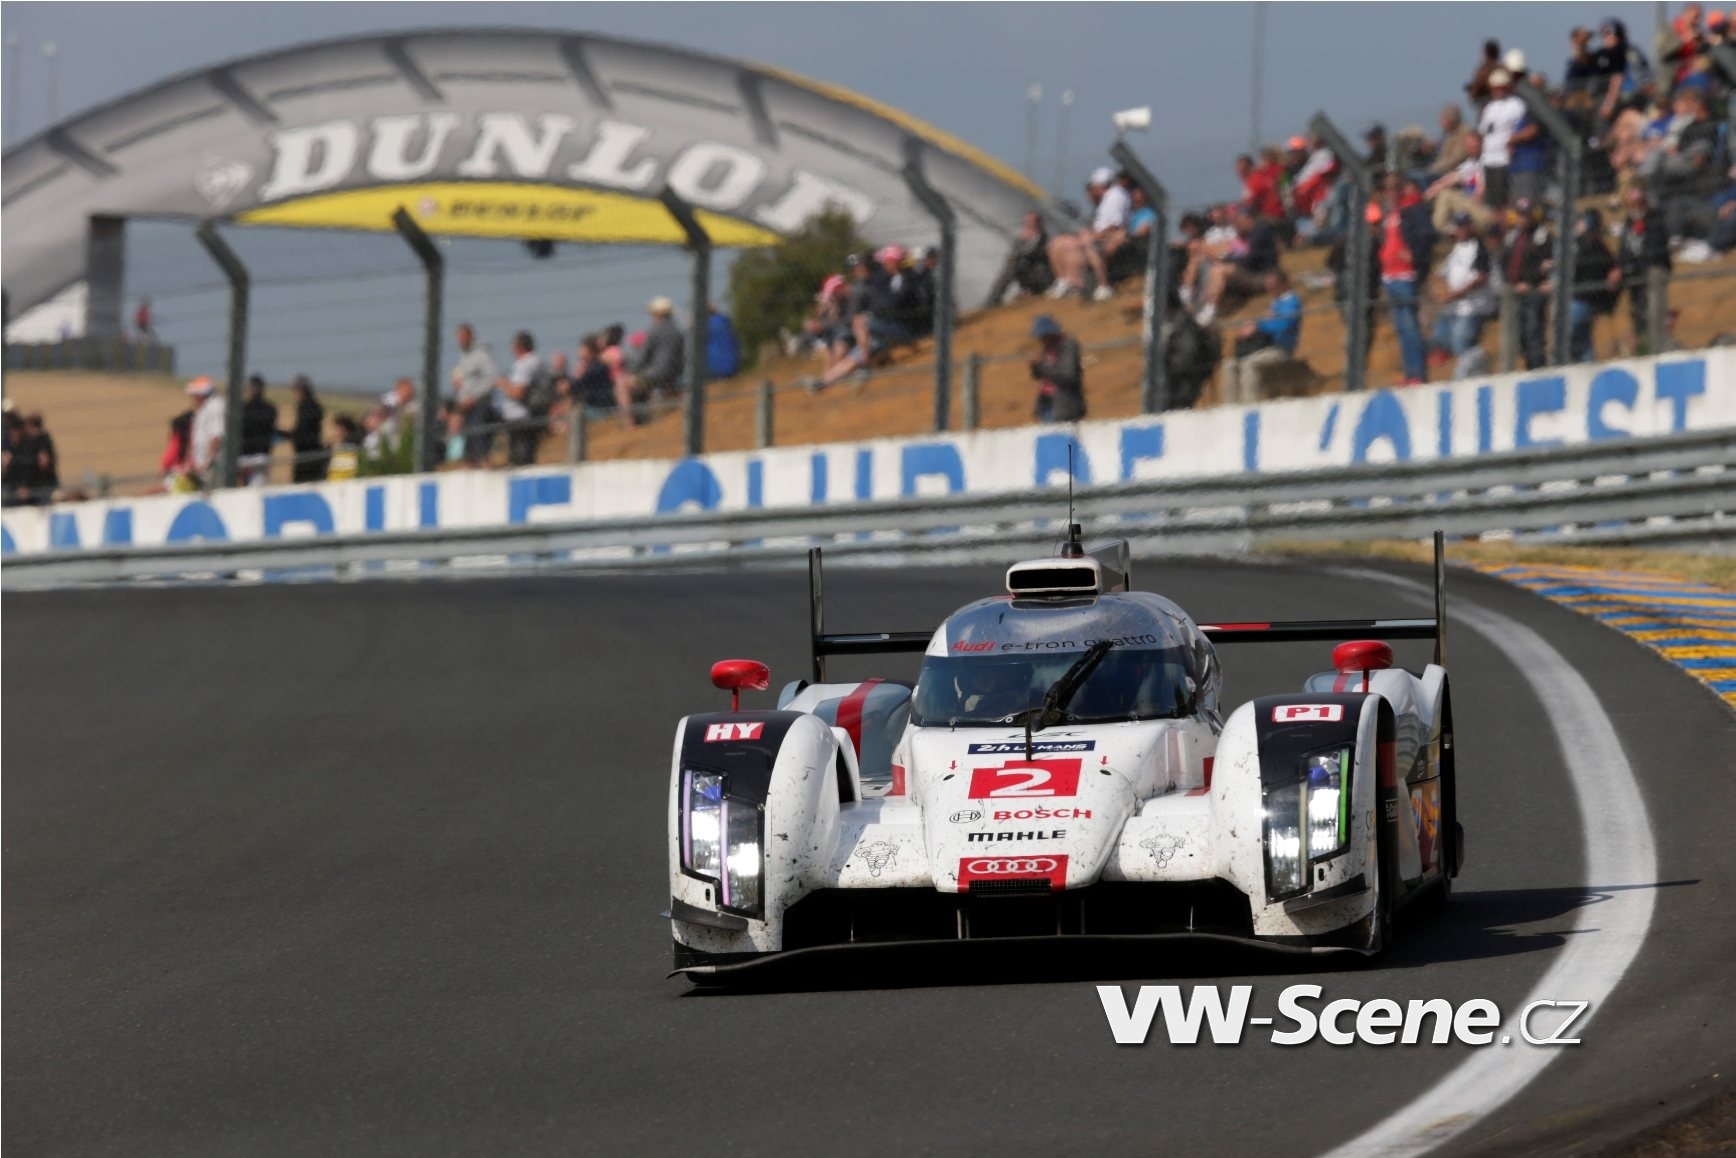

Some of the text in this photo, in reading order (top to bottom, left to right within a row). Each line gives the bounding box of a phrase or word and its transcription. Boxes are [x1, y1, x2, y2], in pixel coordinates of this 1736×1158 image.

[261, 112, 875, 231] DUNLOP
[951, 634, 1157, 652] Audi e-tron qattro
[1286, 706, 1330, 718] P1
[706, 722, 762, 740] HY
[989, 767, 1055, 797] 2
[993, 808, 1092, 821] BOSCH
[968, 829, 1067, 842] MAHLE
